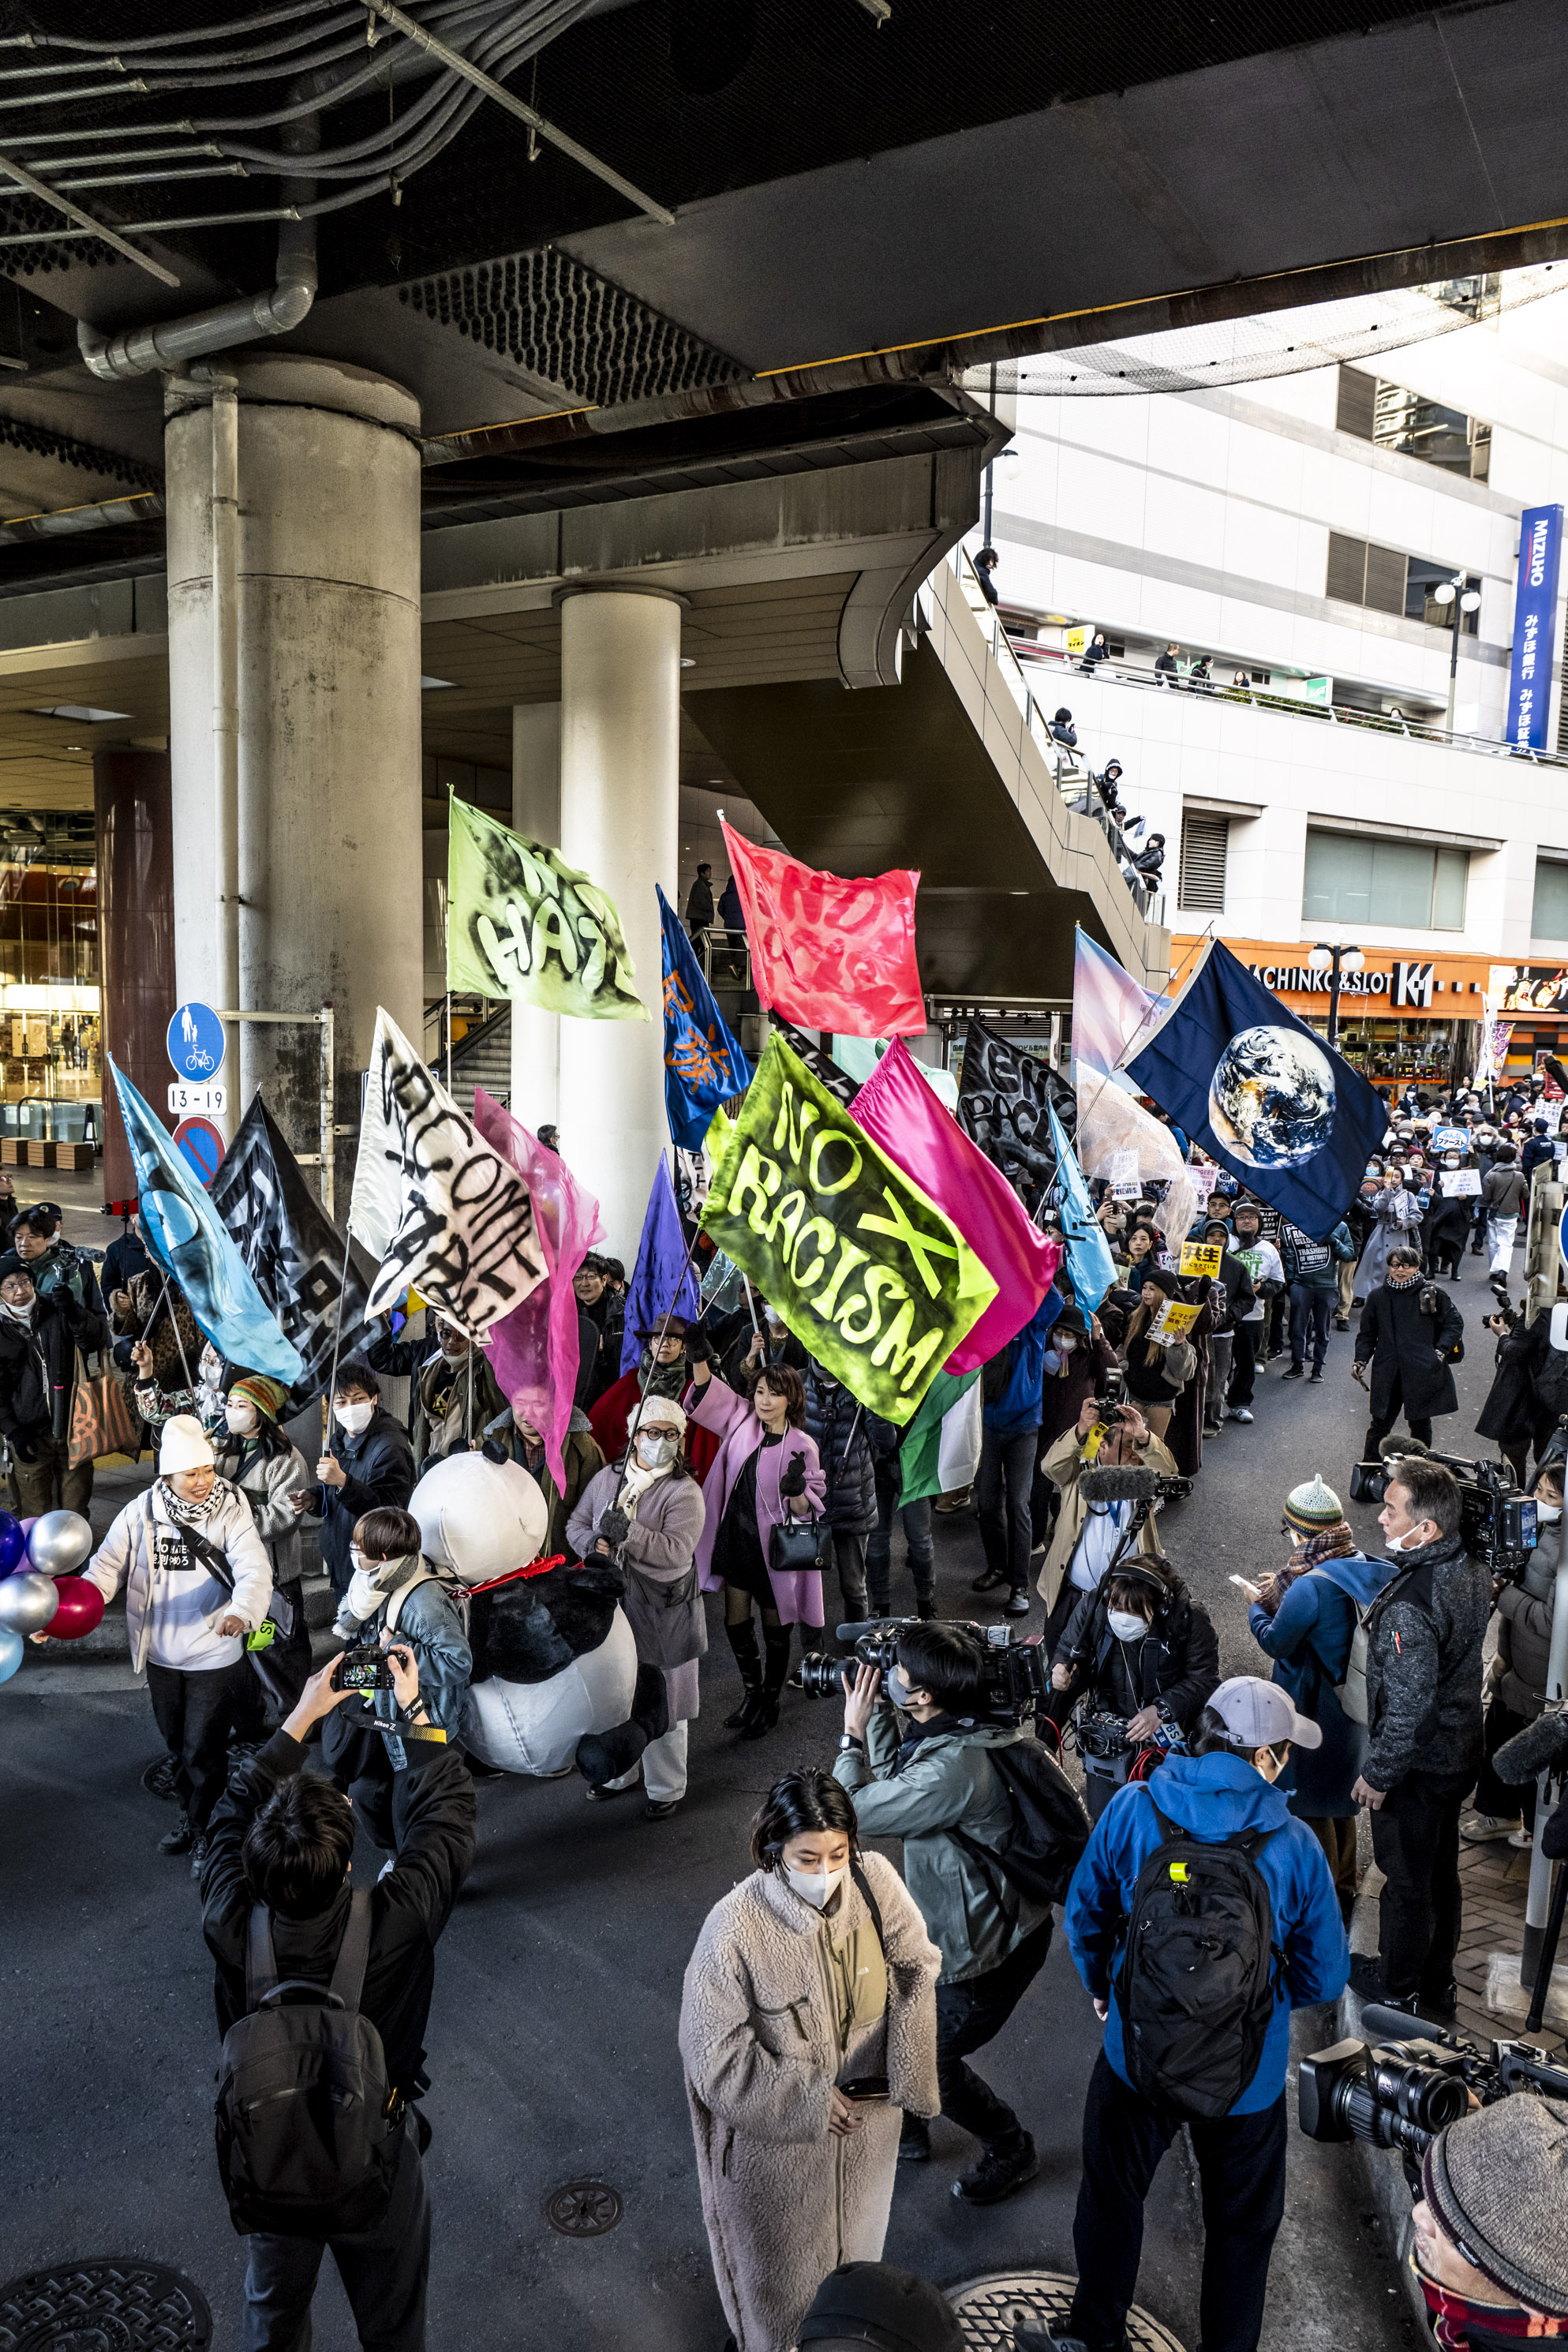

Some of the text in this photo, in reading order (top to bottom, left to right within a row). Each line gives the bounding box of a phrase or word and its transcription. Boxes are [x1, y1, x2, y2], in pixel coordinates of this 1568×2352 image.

[1530, 519, 1548, 587] MIZUHO
[1521, 614, 1538, 680] みずほ銀行
[476, 896, 622, 991] HAT
[773, 1080, 863, 1196] NO
[1438, 1137, 1465, 1147] ファースト
[1184, 1245, 1219, 1263] 共生
[1297, 1245, 1328, 1257] TRASHBIN
[1307, 1253, 1328, 1261] HISTORY!
[727, 1144, 944, 1392] RACISM
[170, 1545, 188, 1554] HATE
[373, 1720, 390, 1728] Nikon
[1166, 1723, 1180, 1740] BS
